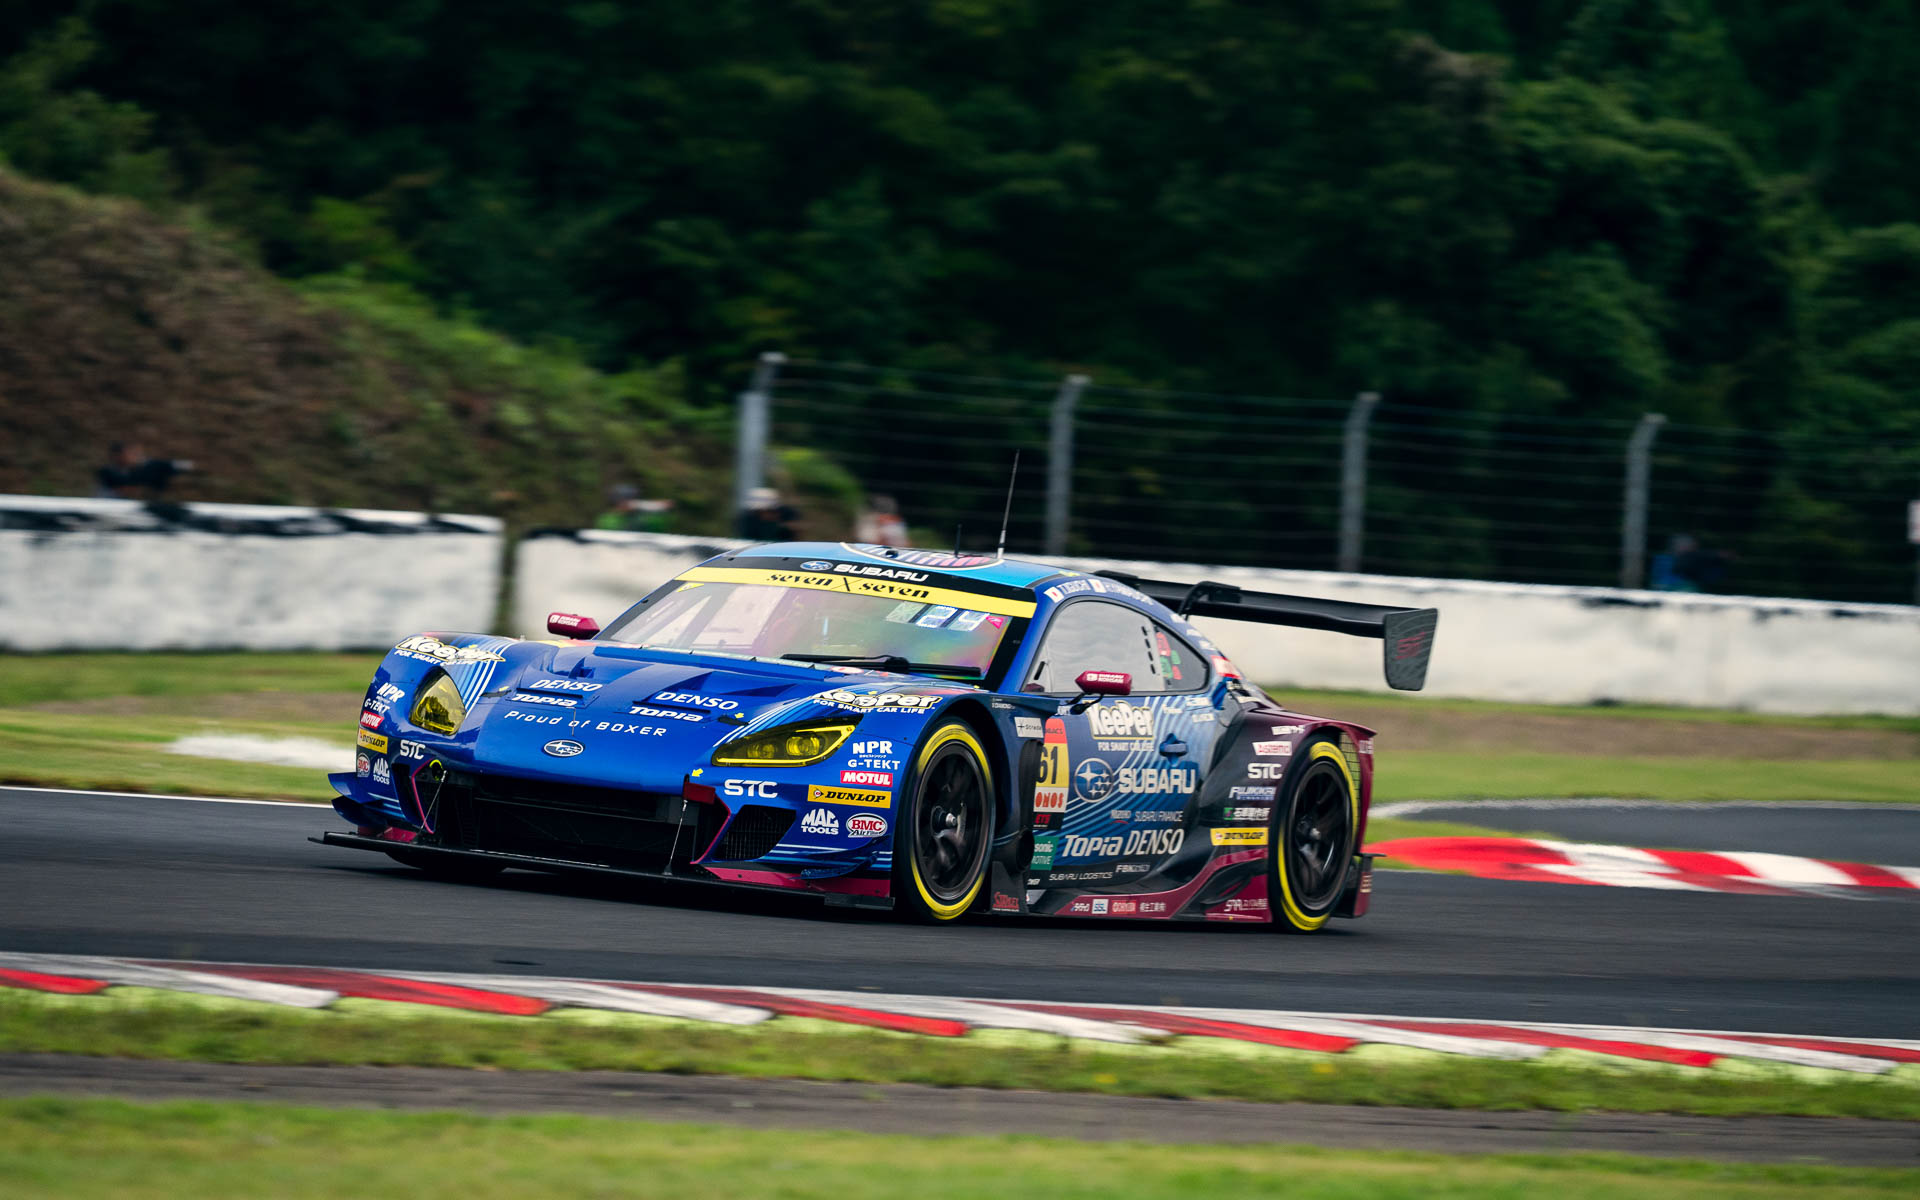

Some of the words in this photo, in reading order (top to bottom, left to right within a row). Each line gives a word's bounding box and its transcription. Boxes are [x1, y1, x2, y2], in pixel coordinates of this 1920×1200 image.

[834, 563, 929, 583] SUBARU
[766, 574, 834, 586] seven
[859, 582, 930, 599] seven
[376, 682, 405, 703] NPR
[529, 679, 603, 692] DENSO
[655, 691, 739, 711] DENSO
[813, 699, 835, 707] FOR
[837, 703, 872, 714] SMART
[504, 711, 562, 725] Proud
[567, 719, 591, 728] of
[595, 721, 667, 737] BOXER
[361, 733, 386, 748] DUNLOP
[400, 739, 426, 760] STC
[852, 740, 893, 755] NPR
[847, 759, 901, 771] G-TEKT
[1036, 745, 1058, 785] 61
[1247, 762, 1283, 780] STC
[373, 774, 390, 785] TOOLS
[842, 771, 892, 786] MOTUL
[1118, 768, 1196, 795] SUBARU
[724, 779, 778, 798] STC
[825, 791, 887, 803] DUNLOP
[801, 808, 839, 828] MAC
[851, 819, 883, 832] BMC
[800, 825, 840, 836] TOOLS
[1034, 840, 1054, 853] sonic
[1123, 828, 1185, 856] DENSO
